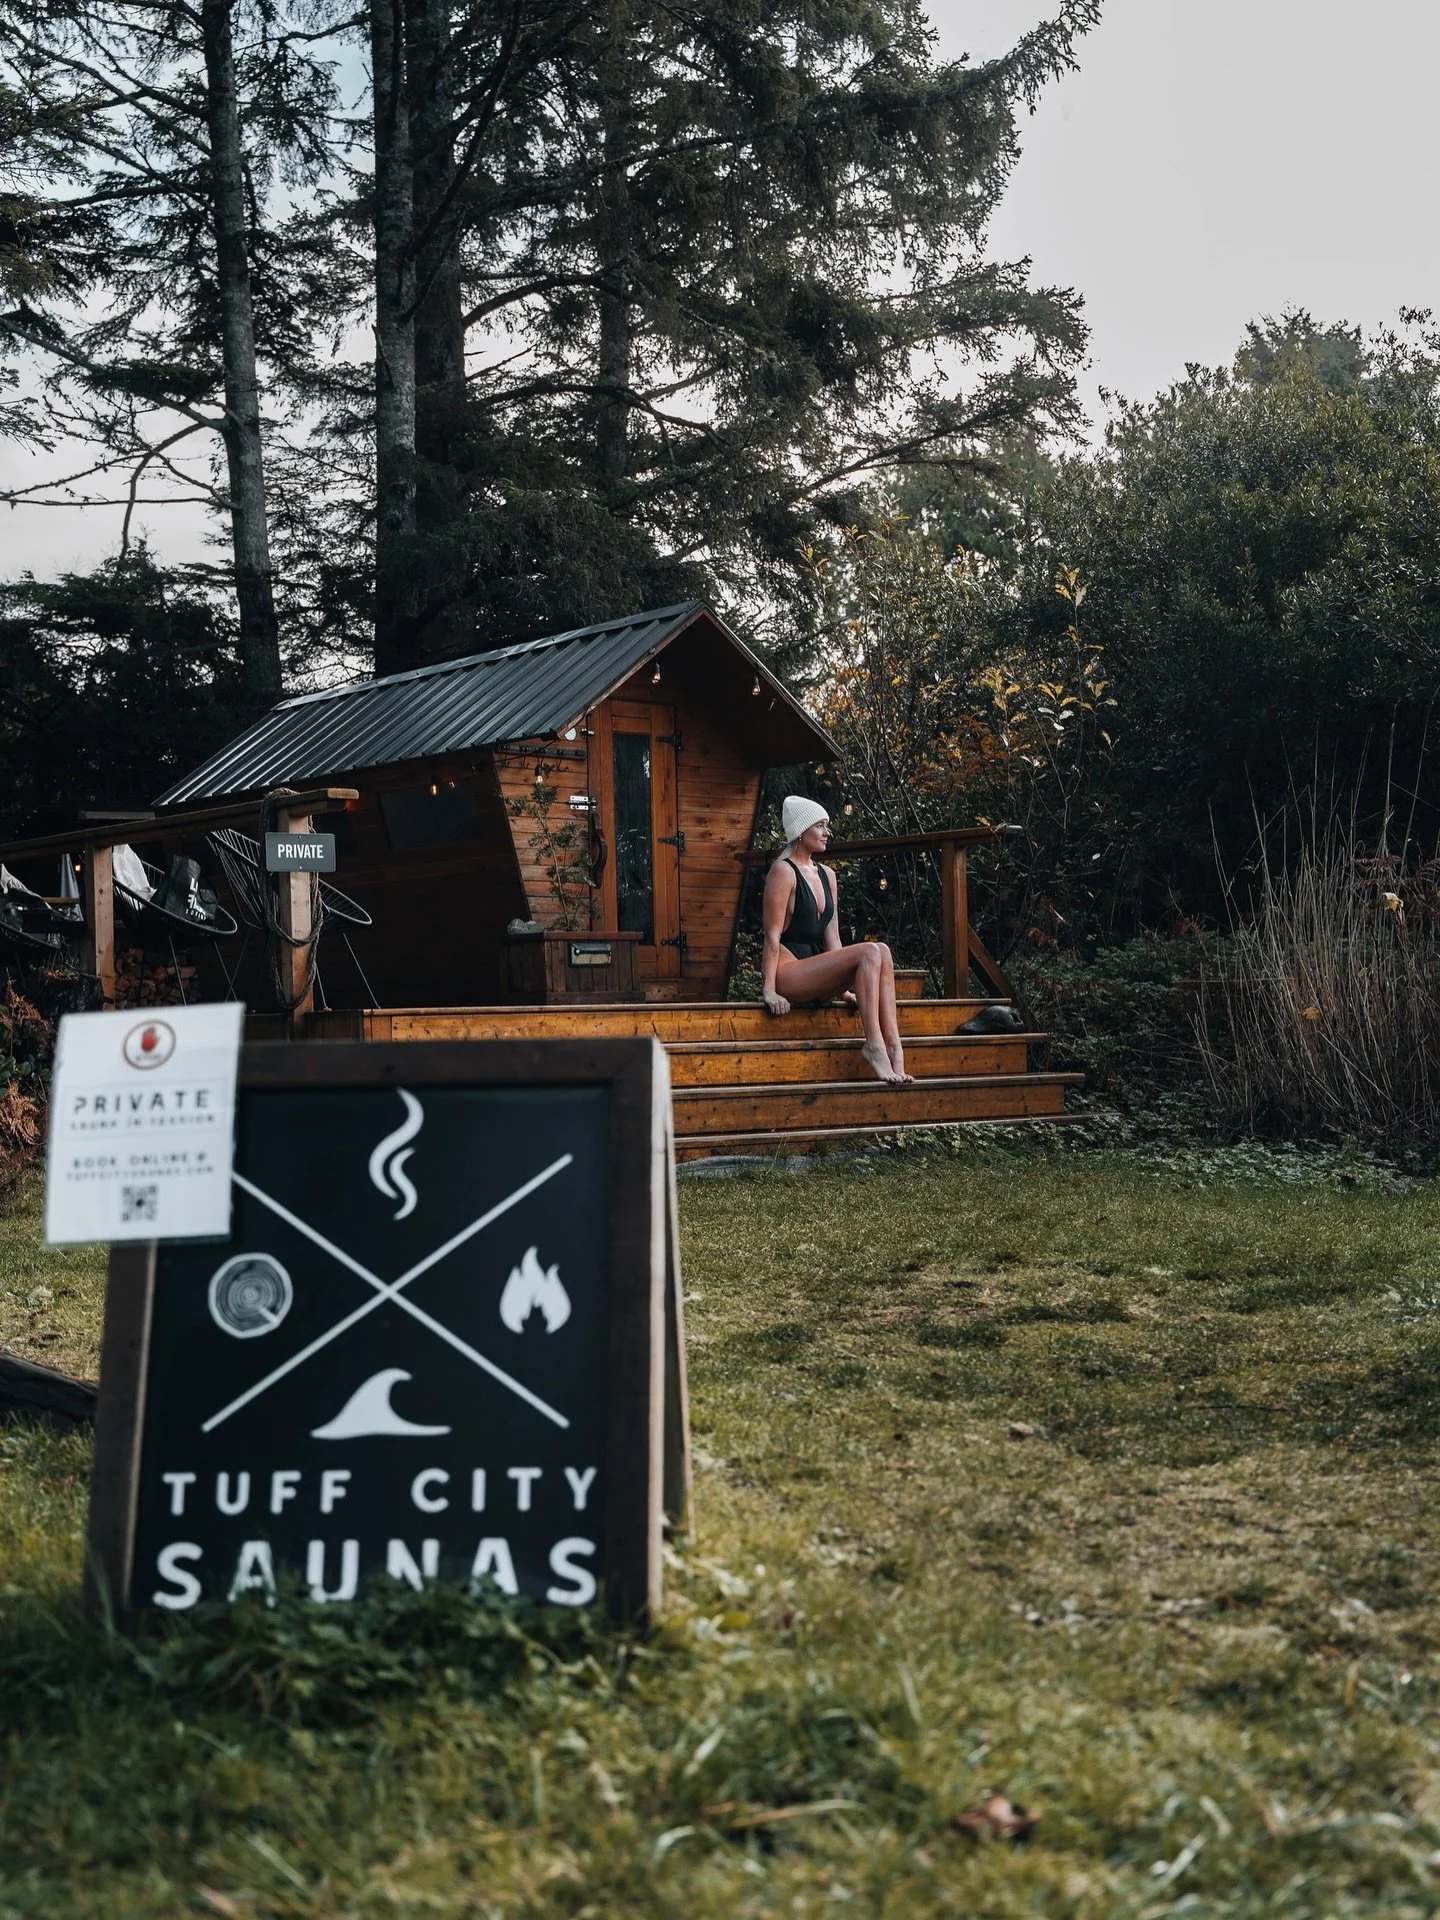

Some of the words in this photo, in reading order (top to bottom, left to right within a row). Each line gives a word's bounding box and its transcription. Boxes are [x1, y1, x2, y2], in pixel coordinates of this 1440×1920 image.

[277, 843, 324, 859] PRIVATE
[73, 1089, 211, 1114] PRIVATE
[73, 1156, 117, 1170] BOOK
[162, 1469, 351, 1515] TUFF
[411, 1467, 597, 1513] CITY
[153, 1536, 597, 1609] SAUNAS
